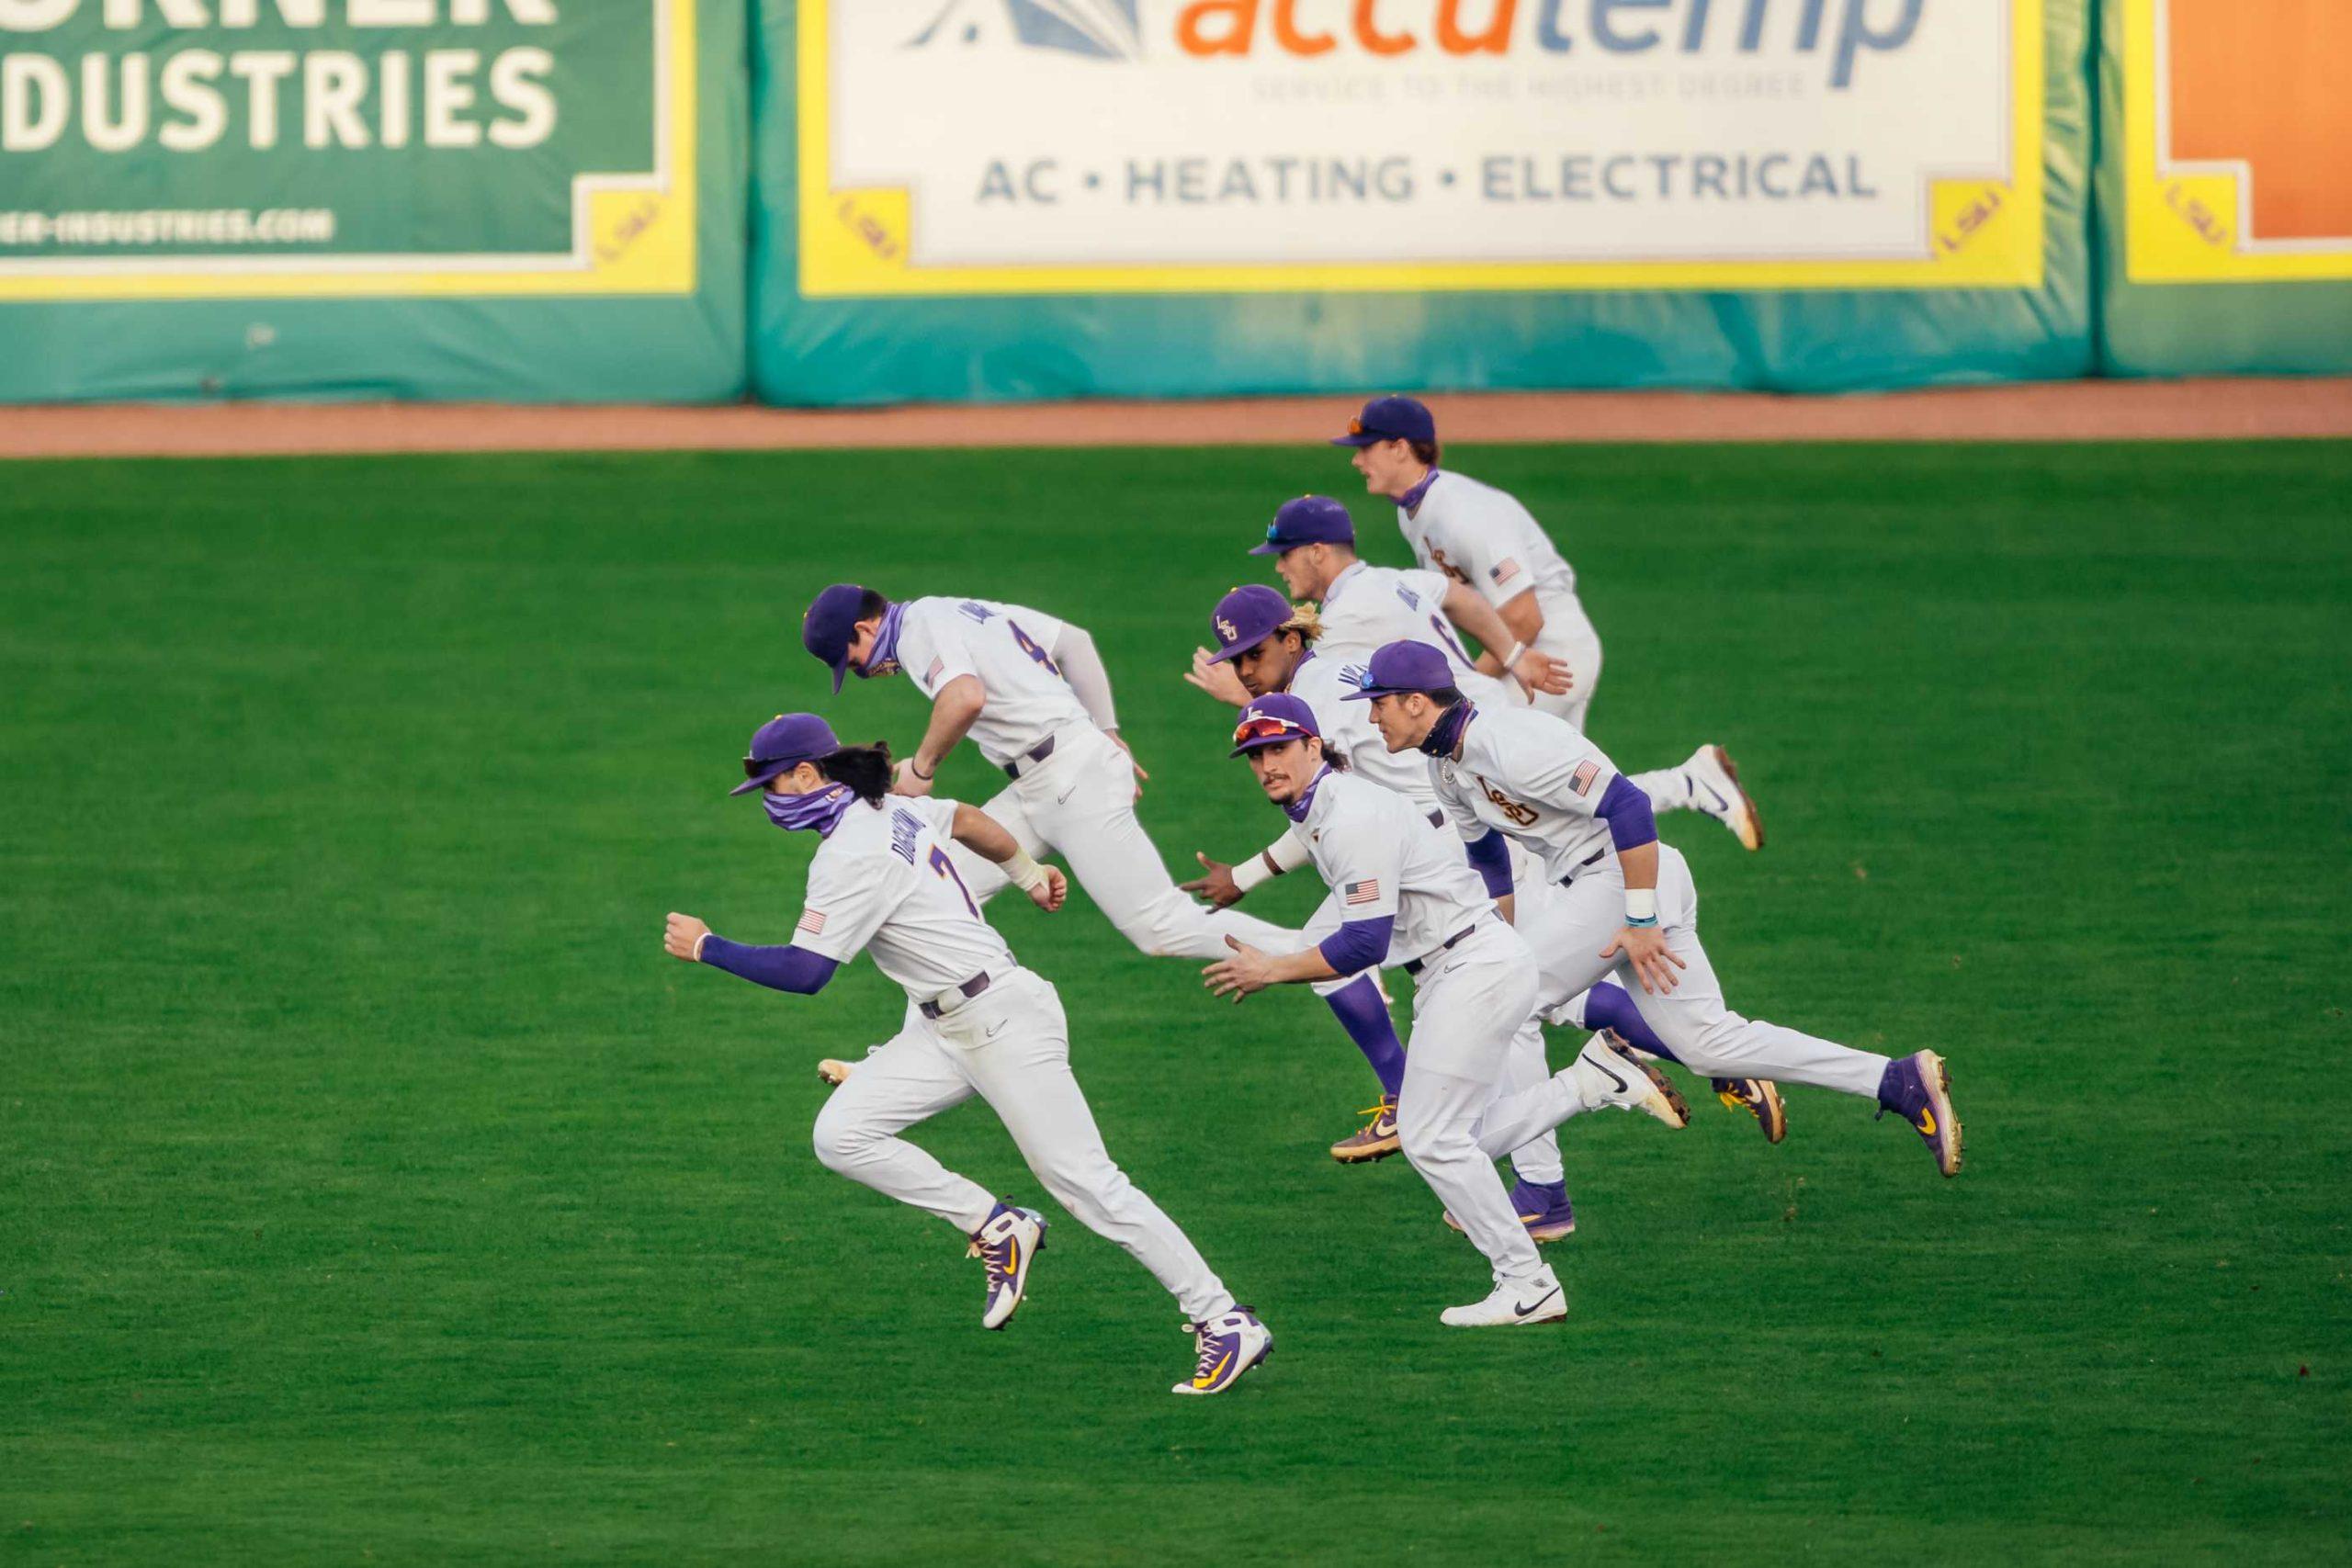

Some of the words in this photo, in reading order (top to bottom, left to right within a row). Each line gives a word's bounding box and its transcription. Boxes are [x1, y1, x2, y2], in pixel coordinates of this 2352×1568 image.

[3, 47, 557, 152] DUSTRIES
[977, 158, 1057, 205] AC
[1125, 156, 1415, 204] HEATING
[1482, 152, 1879, 201] ELECTRICAL
[1007, 618, 1060, 677] 4
[1216, 615, 1238, 641] LSU
[1476, 775, 1539, 826] LSU
[927, 842, 979, 920] 7
